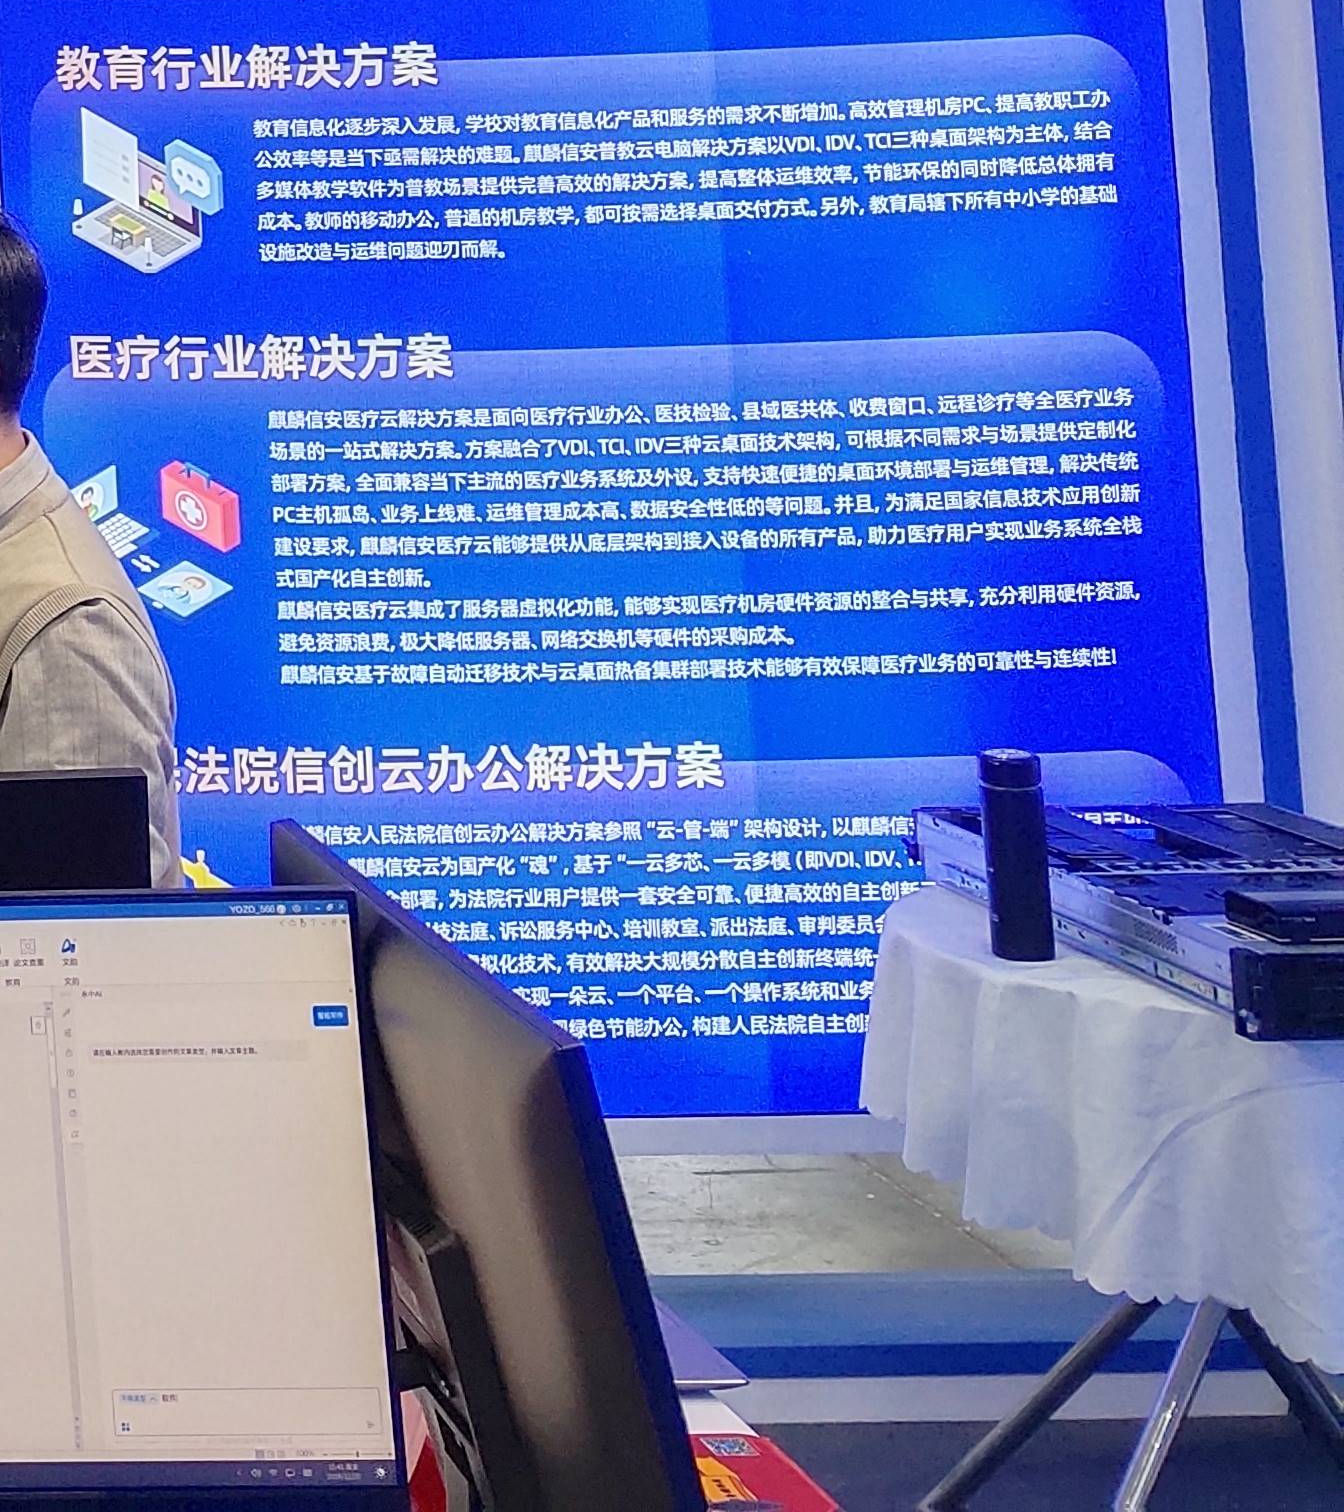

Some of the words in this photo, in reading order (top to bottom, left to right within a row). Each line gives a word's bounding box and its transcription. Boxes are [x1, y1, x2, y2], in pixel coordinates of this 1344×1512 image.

[56, 40, 440, 92] 教育行业解决方案
[259, 236, 507, 263] 设施改造与运维问题迎刃而解。
[69, 333, 455, 381] 医疗行业解决方案
[275, 566, 432, 590] 式国产化自主创新。
[173, 741, 726, 795] 法院信创云办公解决方案
